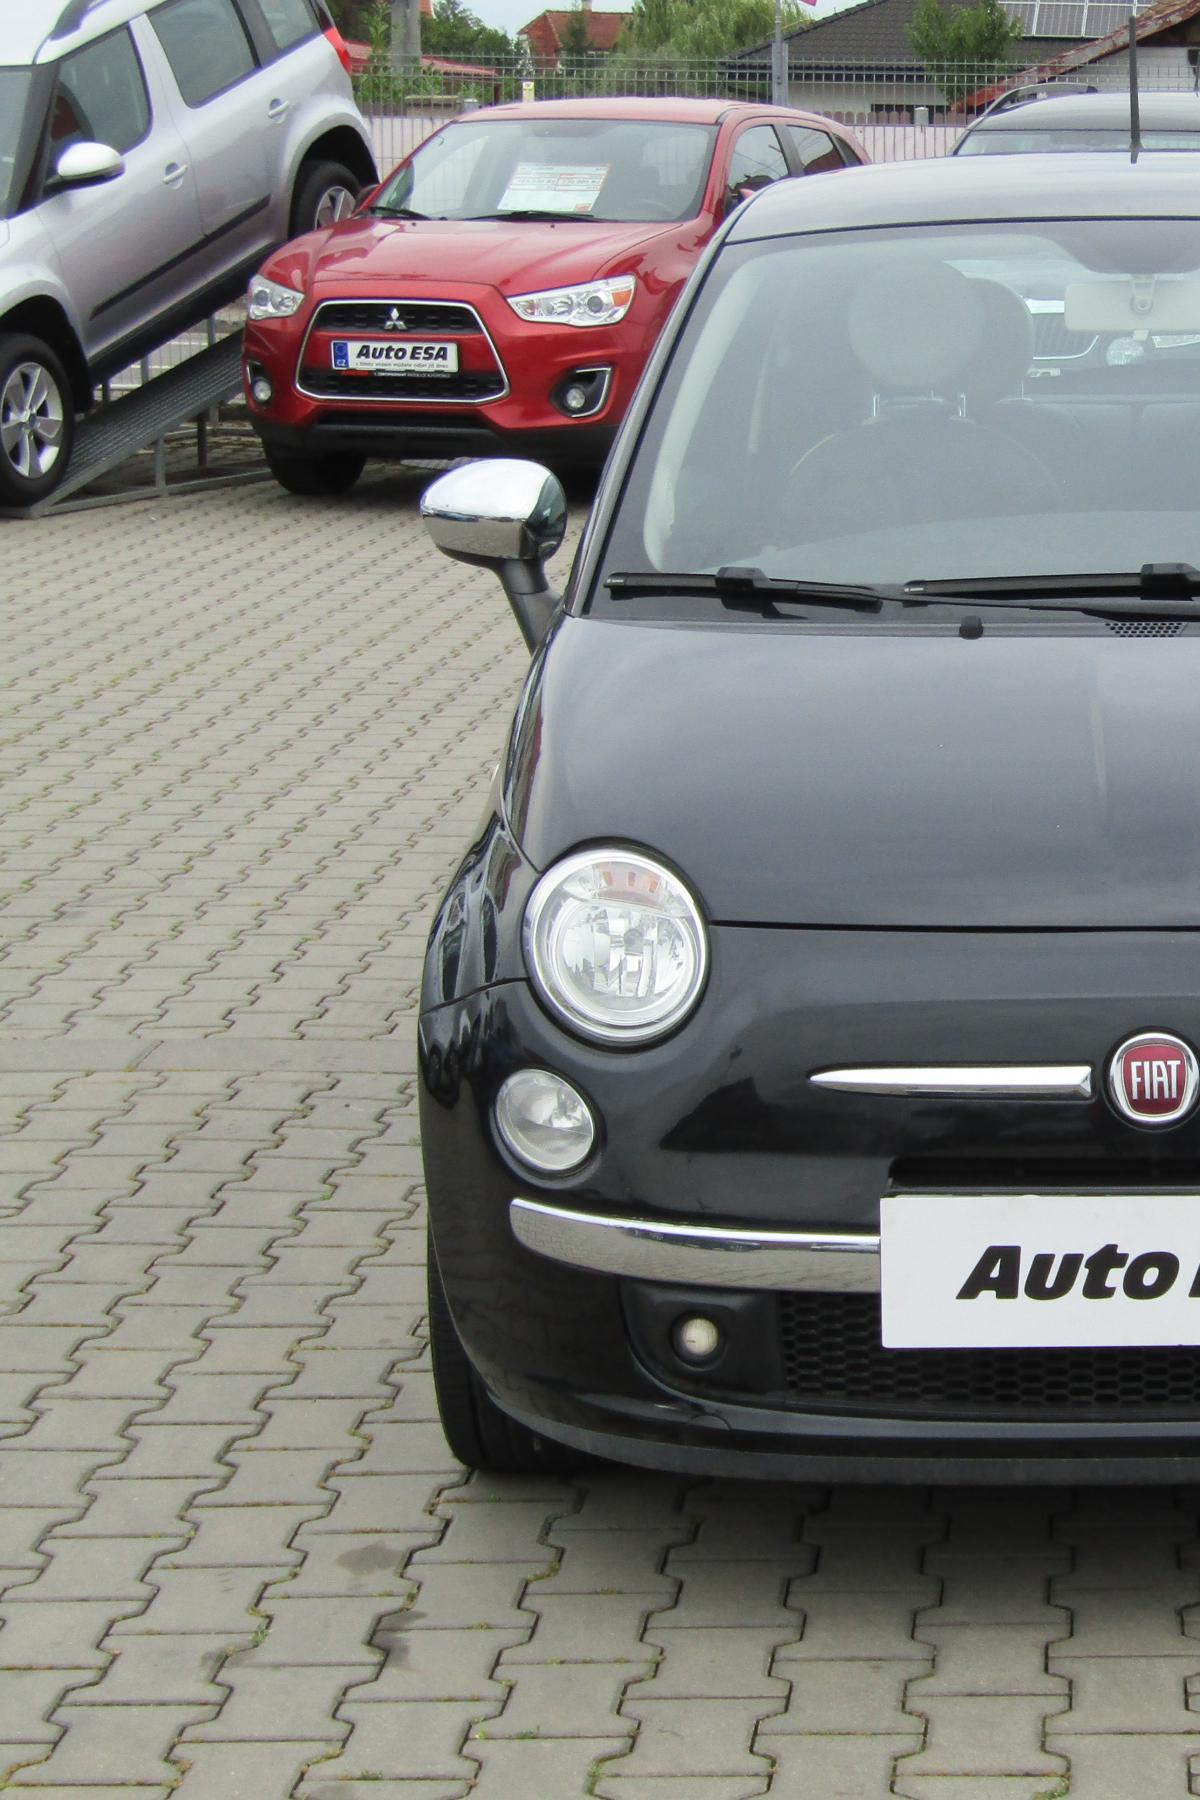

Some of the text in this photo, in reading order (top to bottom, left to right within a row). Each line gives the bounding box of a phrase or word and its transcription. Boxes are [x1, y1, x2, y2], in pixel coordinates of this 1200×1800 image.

[336, 359, 346, 367] CZ
[356, 345, 448, 361] Auto ESA
[1130, 1060, 1181, 1100] FIAT
[956, 1243, 1180, 1301] Auto
